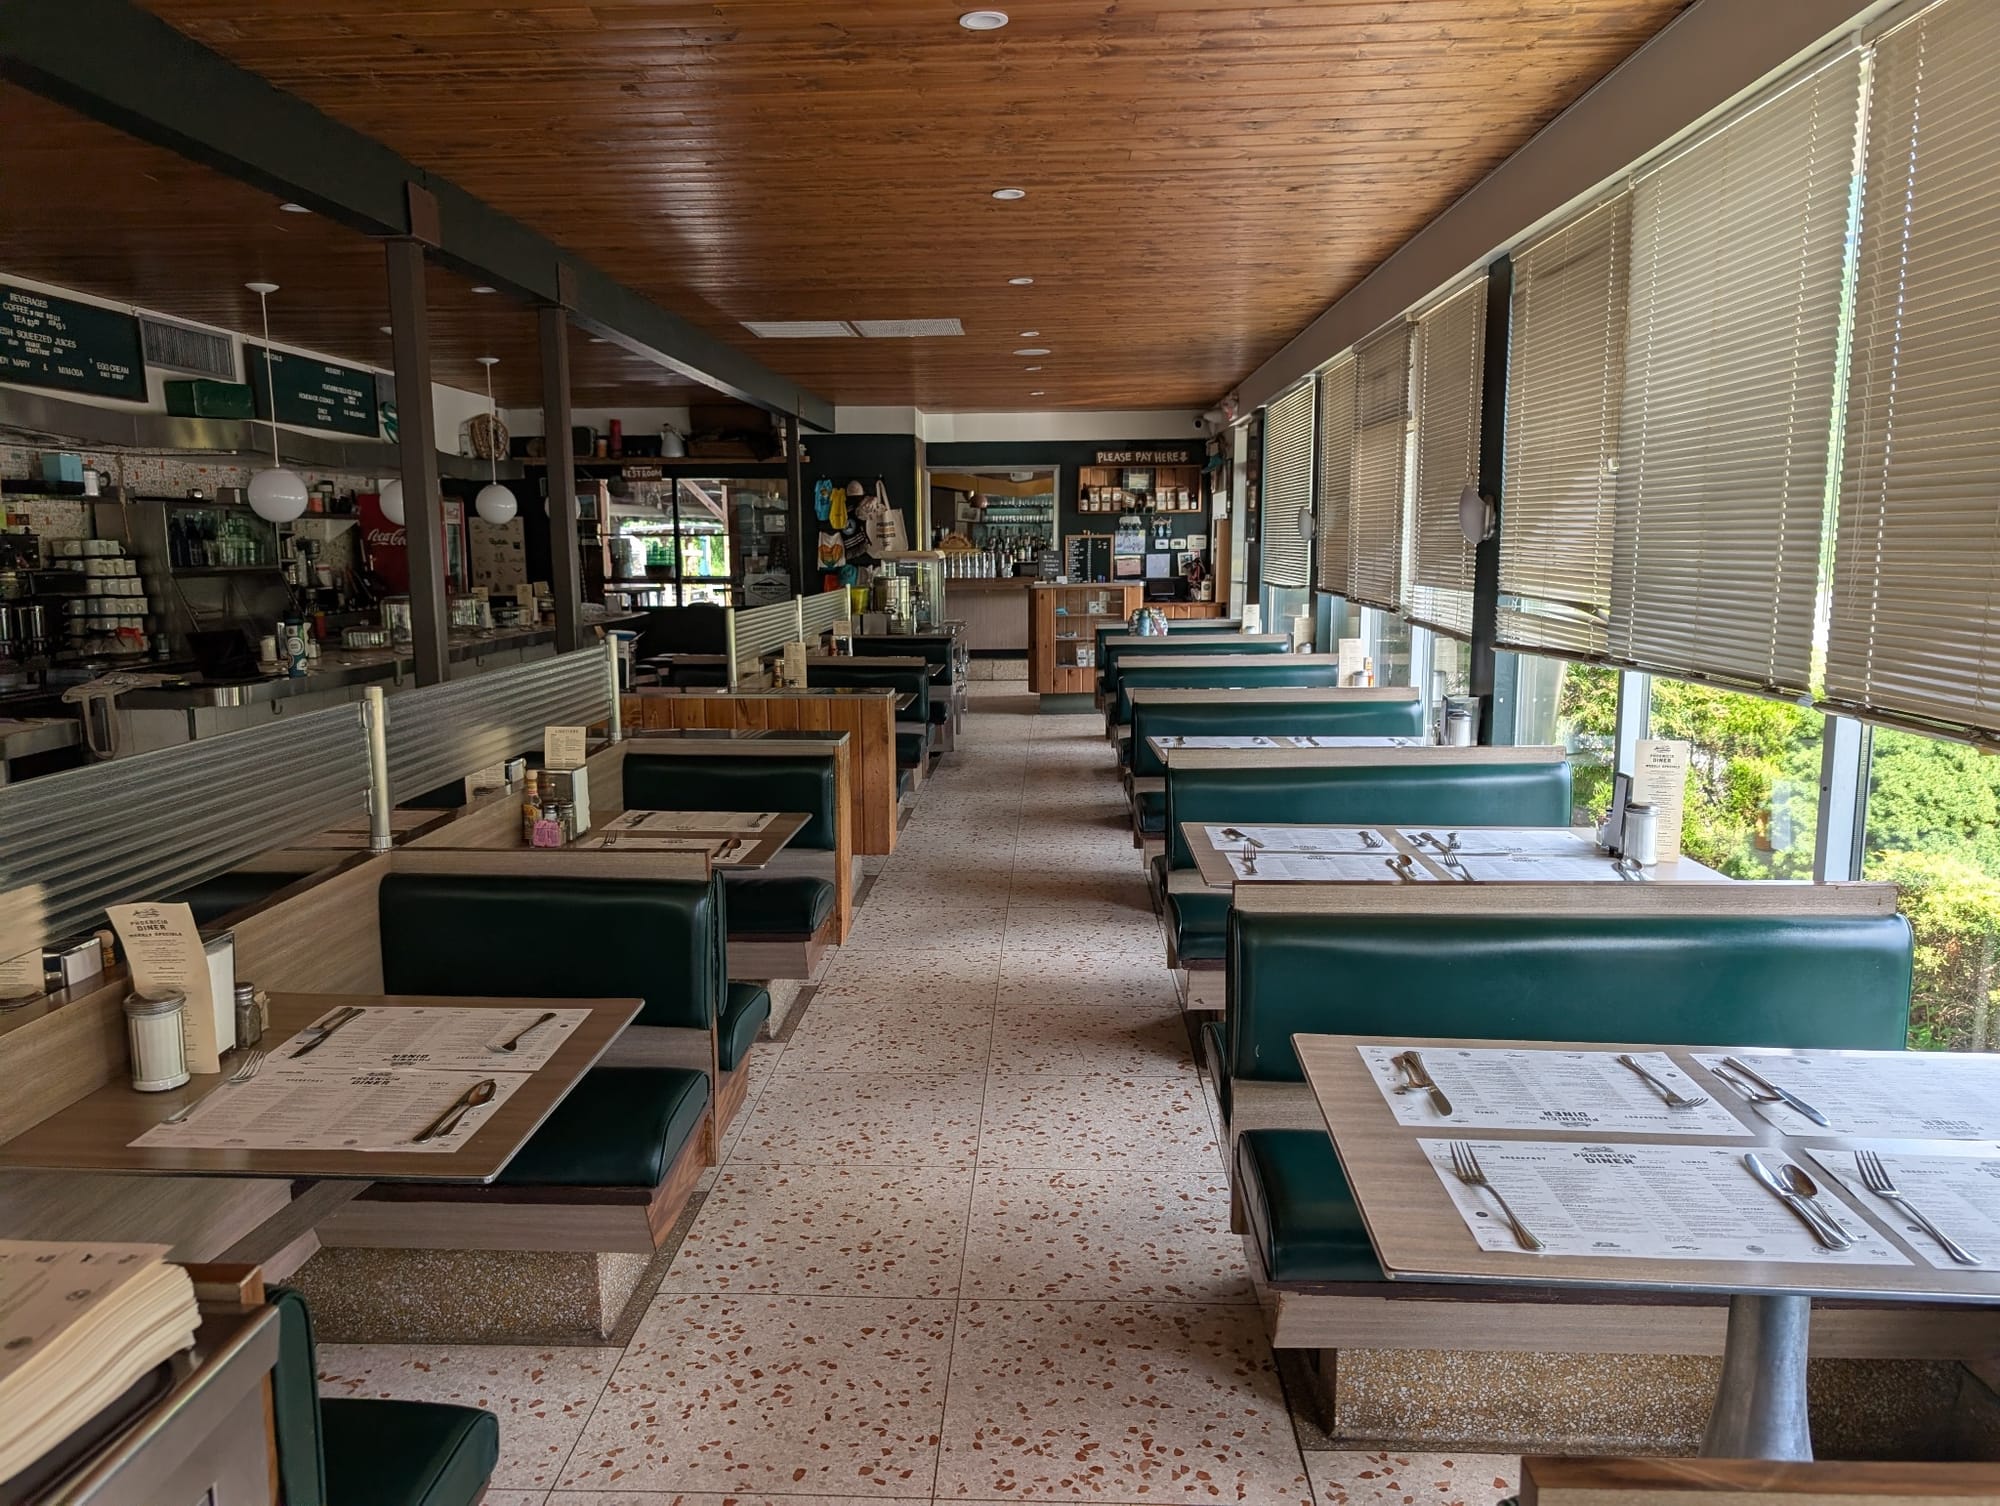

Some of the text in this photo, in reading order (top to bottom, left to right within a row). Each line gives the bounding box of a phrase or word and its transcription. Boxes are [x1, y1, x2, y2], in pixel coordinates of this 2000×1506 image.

[10, 293, 48, 309] BEVERAGES
[2, 302, 30, 316] COFFEE
[12, 314, 27, 325] TEA
[16, 329, 53, 344] SQUEEZED
[55, 337, 77, 349] JUICES
[1097, 451, 1179, 463] PLEASE PAY HERE
[367, 528, 407, 546] Coca-Co
